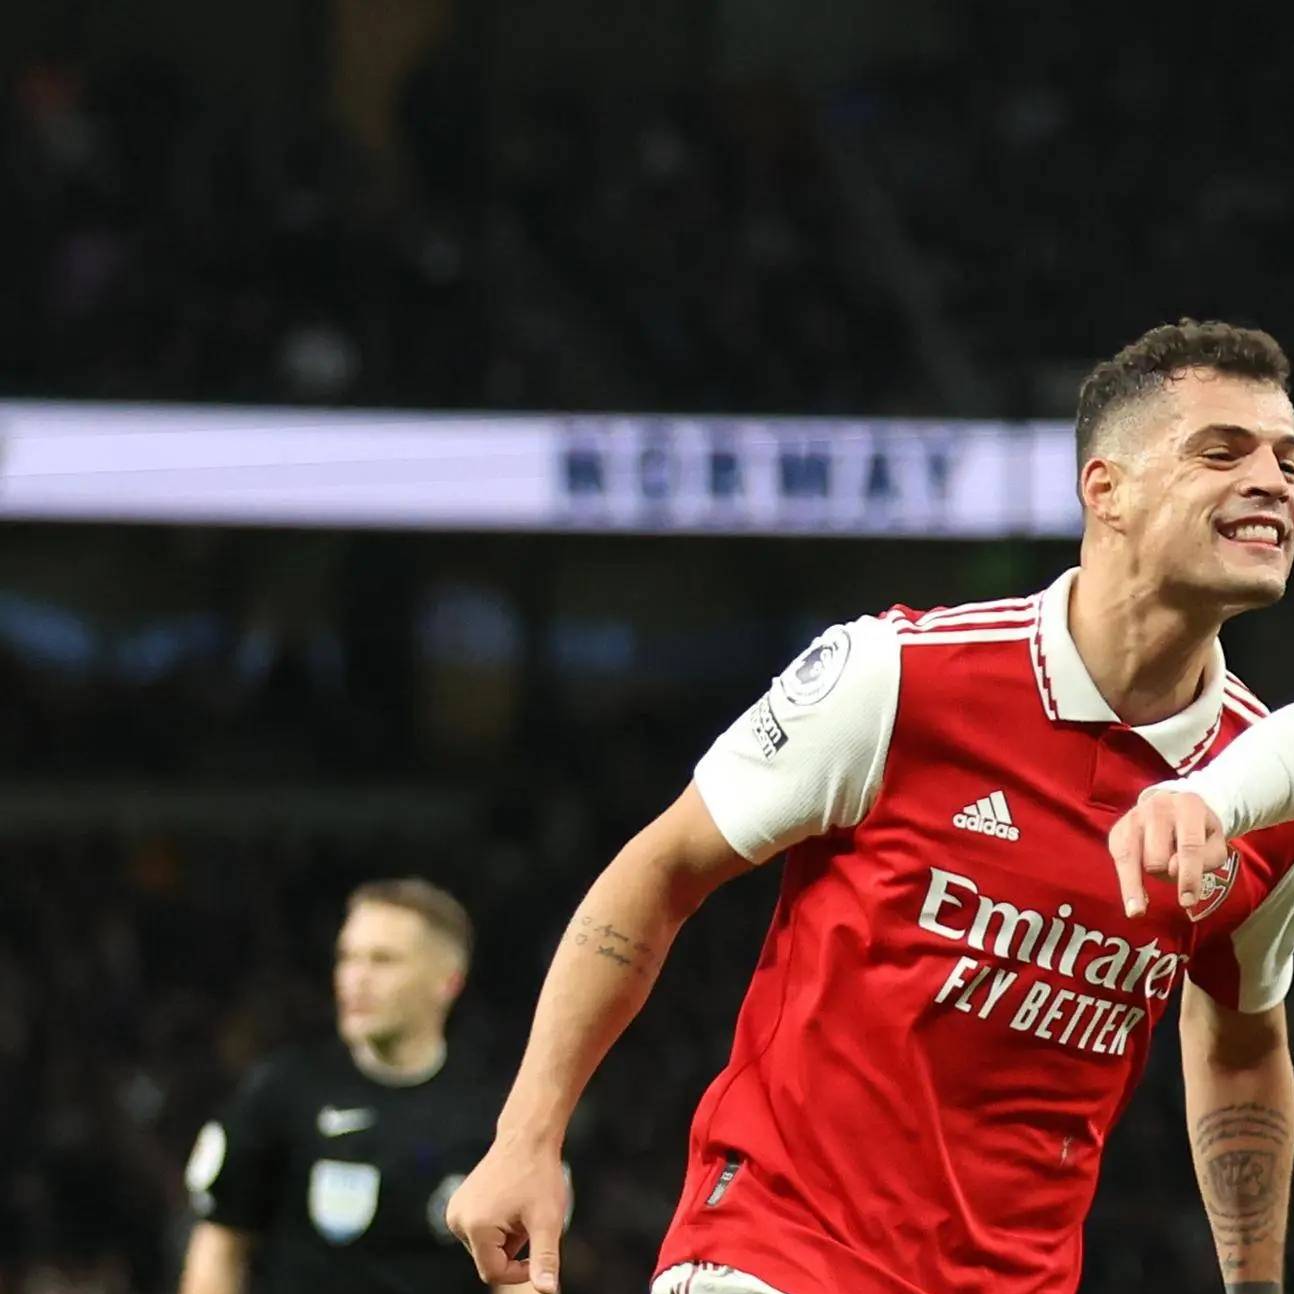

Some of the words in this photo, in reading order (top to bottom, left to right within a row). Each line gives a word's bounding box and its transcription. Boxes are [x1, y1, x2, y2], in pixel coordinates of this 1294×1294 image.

[952, 812, 1021, 842] adidas
[917, 866, 1189, 1000] Emirates
[934, 956, 1019, 1021] FLY
[1009, 979, 1146, 1056] BETTER
